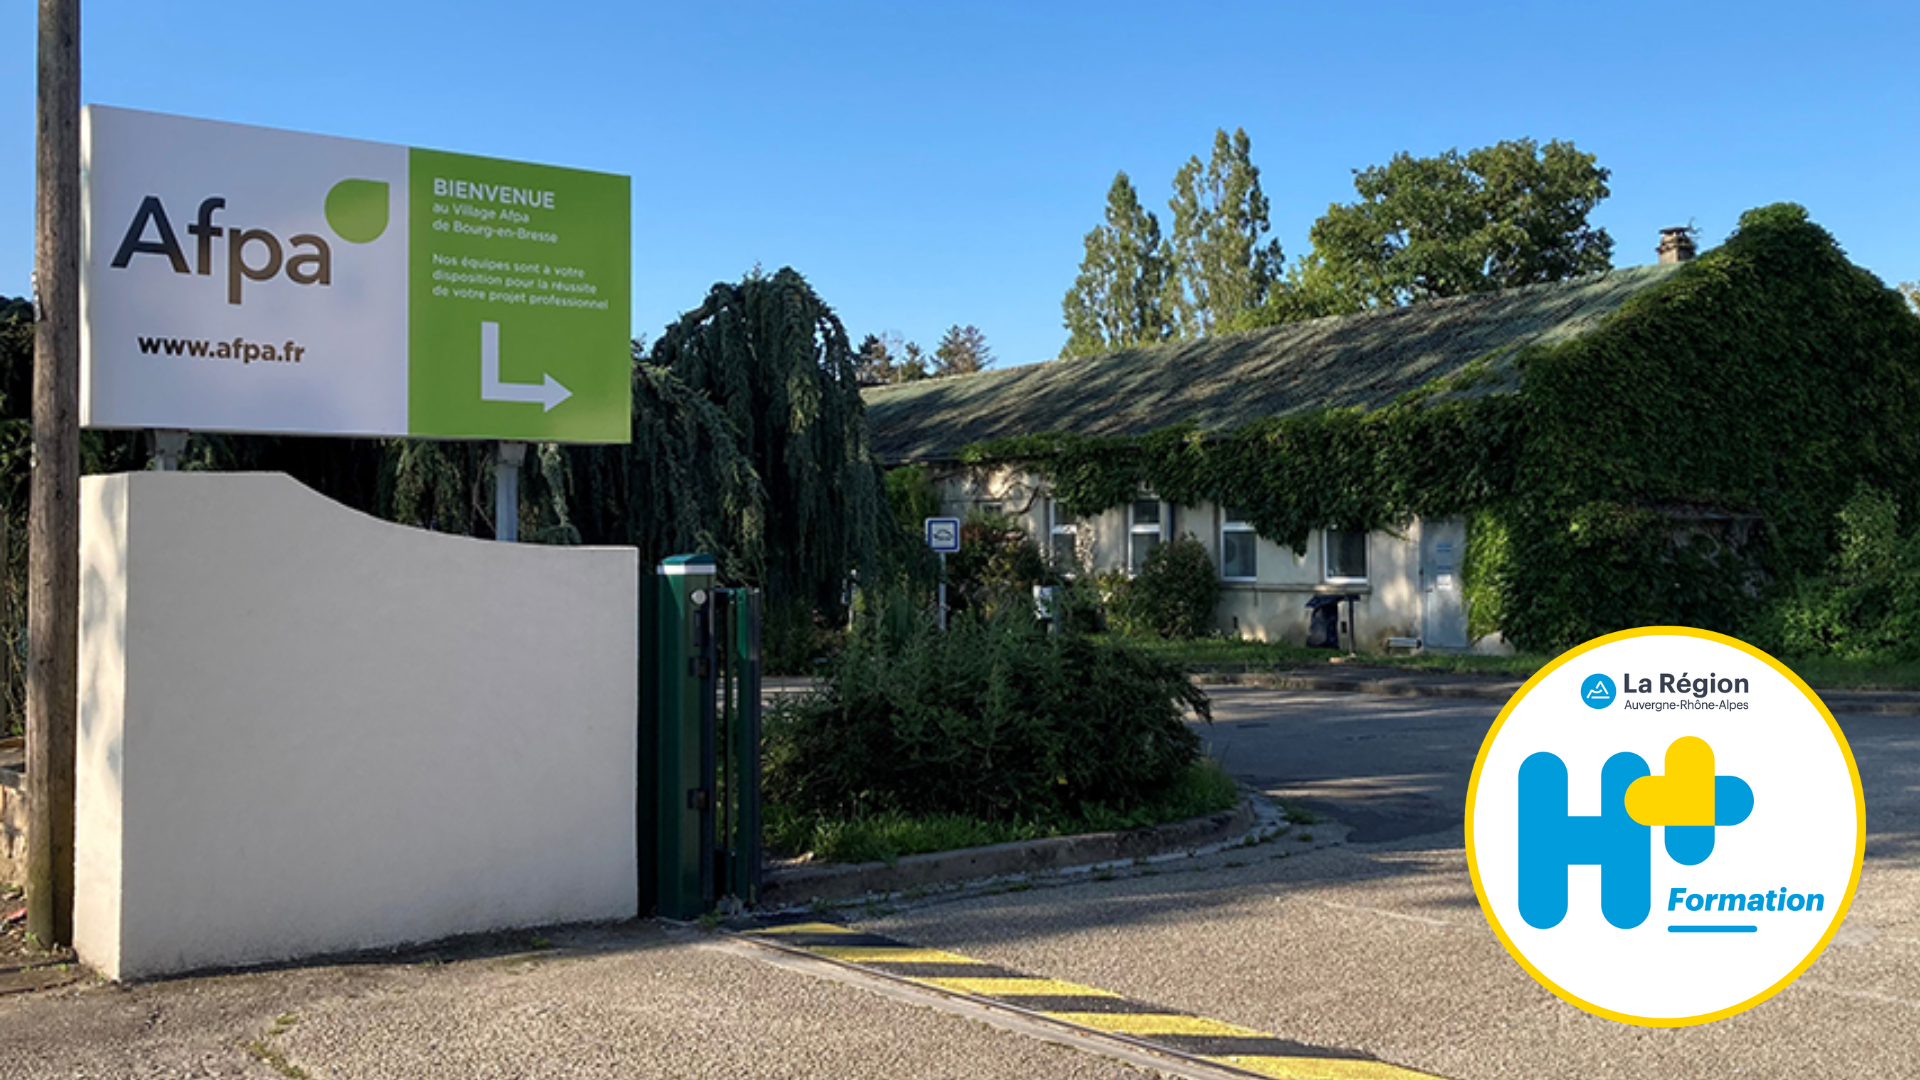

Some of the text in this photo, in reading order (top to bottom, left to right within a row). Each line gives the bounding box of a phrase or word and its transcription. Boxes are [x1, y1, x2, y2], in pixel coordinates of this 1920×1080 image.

[434, 177, 555, 209] BIENVENUE
[433, 203, 530, 223] au Village Afpa
[432, 219, 558, 243] de Bourg-en-Bresse
[110, 195, 331, 305] Afpa
[433, 254, 585, 278] Nos équipes sont à votre
[432, 270, 597, 295] disposition pour la réussite
[432, 285, 608, 310] de votre projet professionnel
[138, 336, 305, 364] www.afpa.fr
